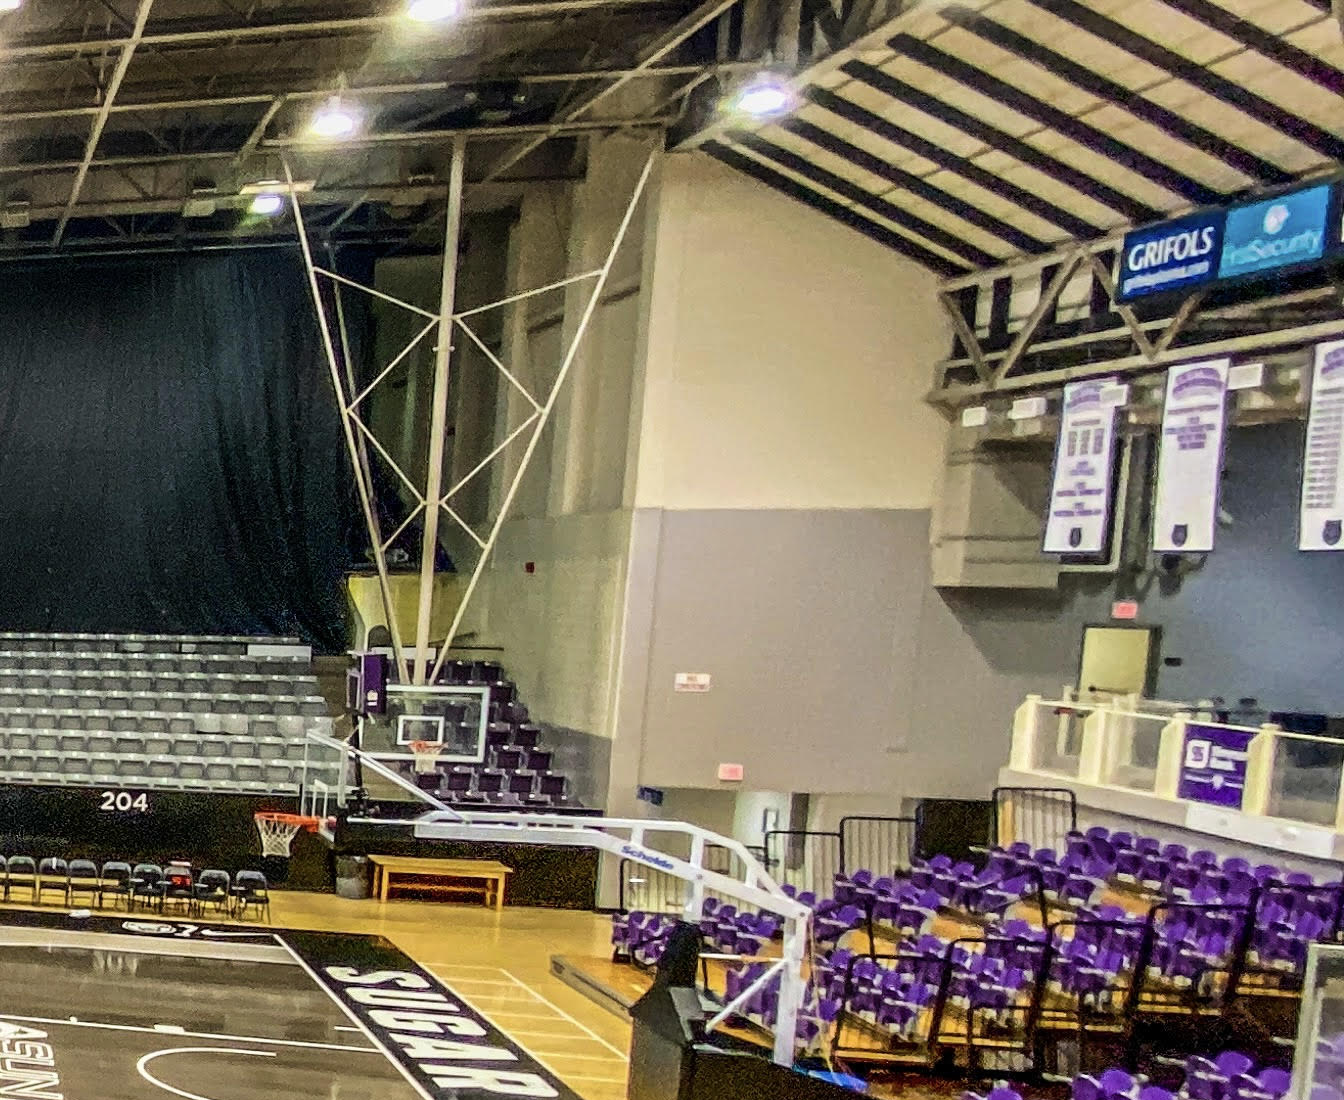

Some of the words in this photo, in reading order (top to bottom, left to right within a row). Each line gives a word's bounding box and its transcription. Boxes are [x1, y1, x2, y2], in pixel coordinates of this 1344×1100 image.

[1128, 226, 1215, 272] GRIFOLS
[101, 791, 148, 812] 204
[326, 965, 560, 1099] SUGAR
